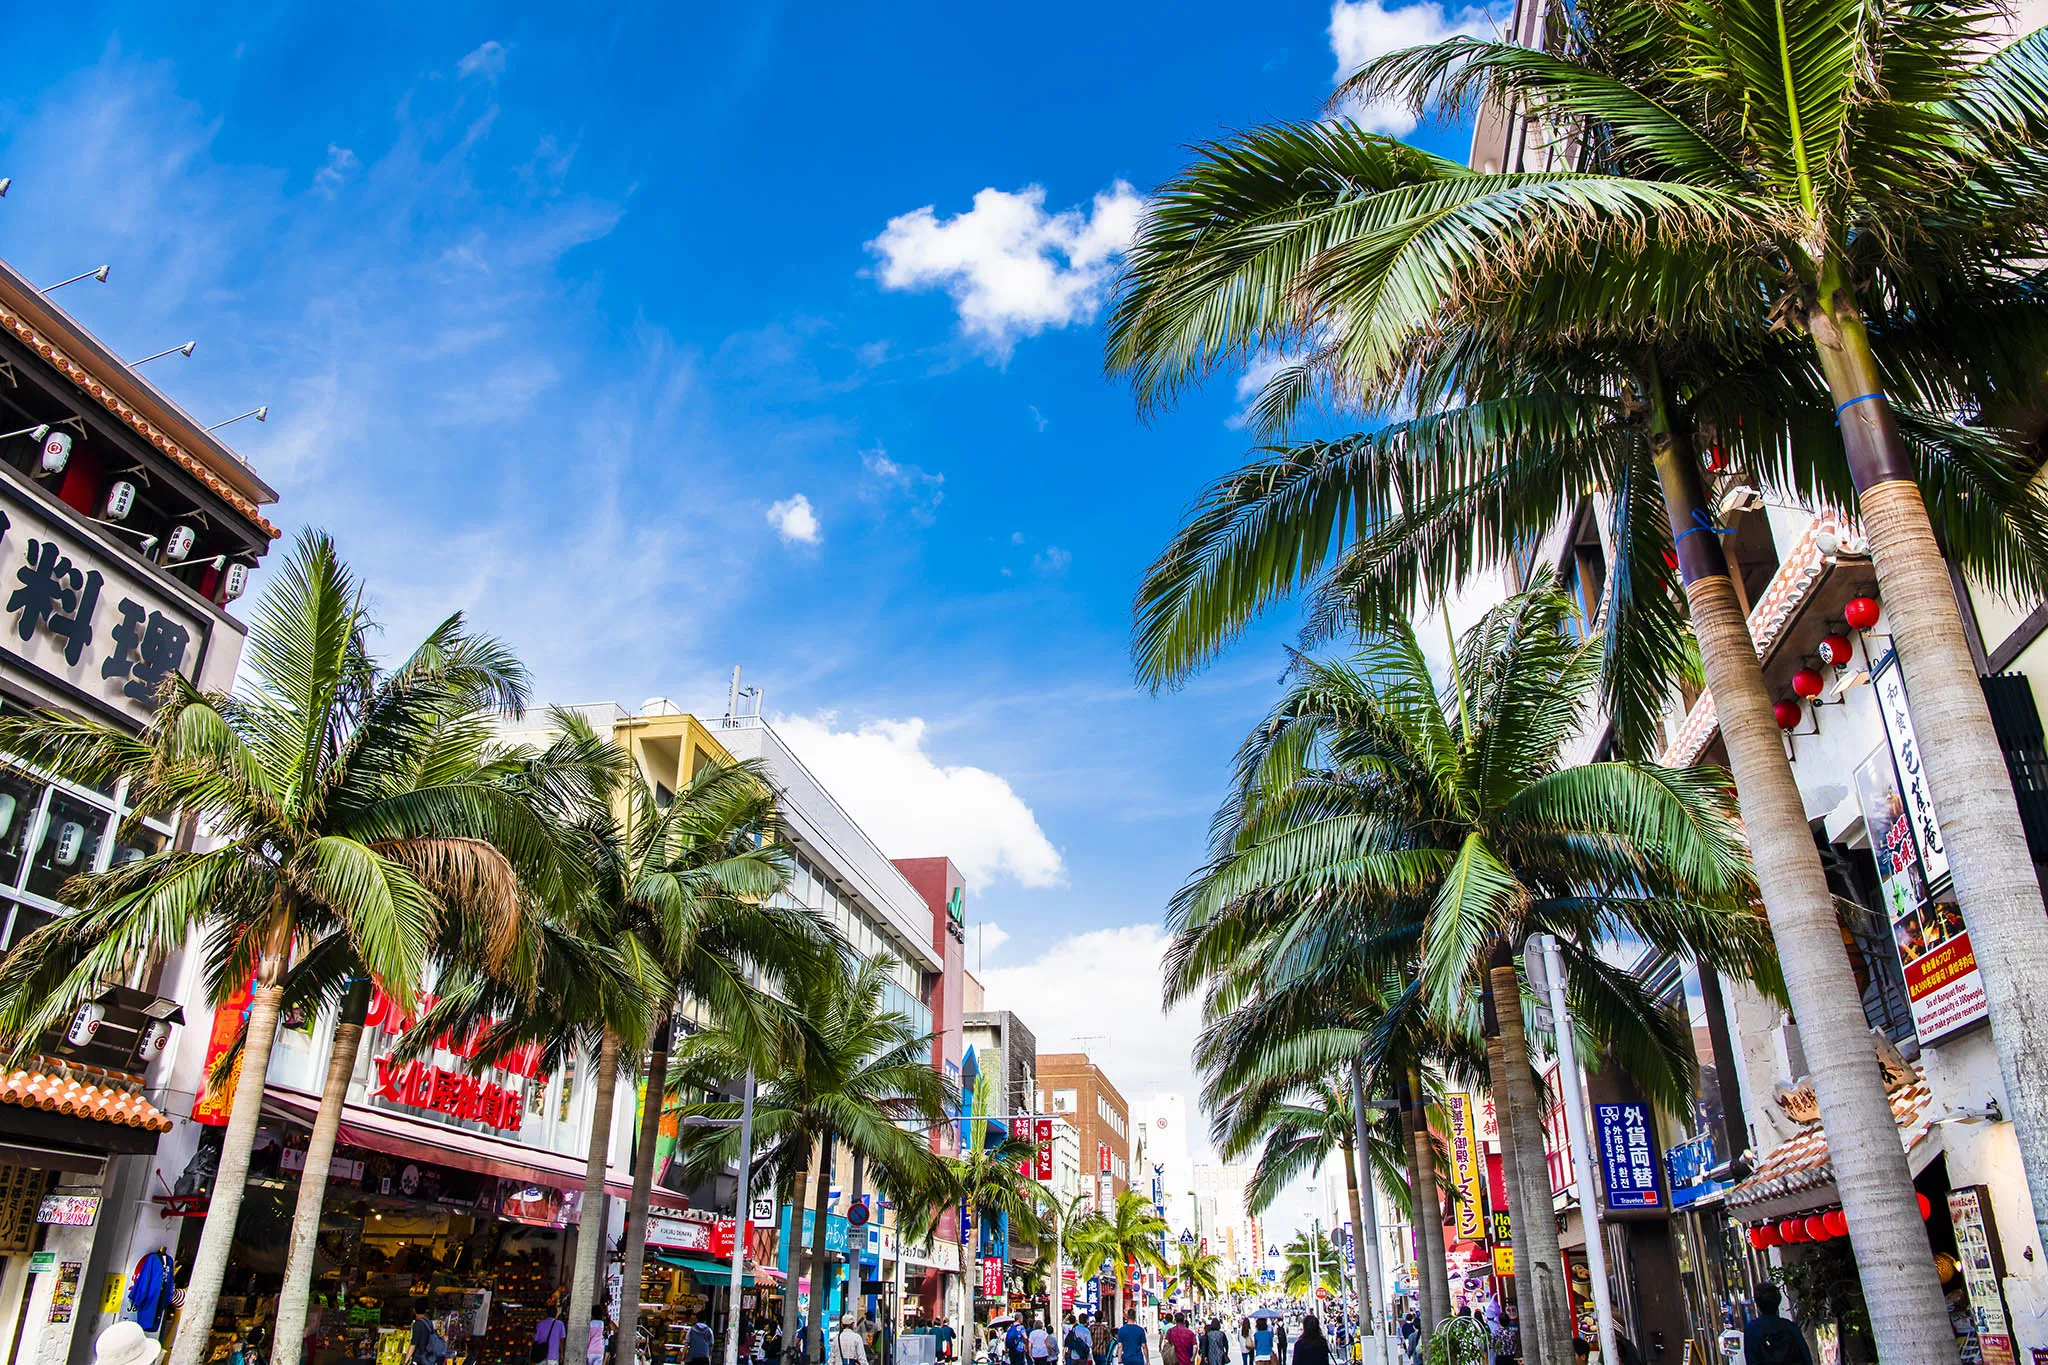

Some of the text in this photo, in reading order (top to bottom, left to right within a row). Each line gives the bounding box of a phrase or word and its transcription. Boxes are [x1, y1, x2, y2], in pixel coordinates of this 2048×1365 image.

[0, 510, 190, 706] 料理
[1603, 1126, 1618, 1190] Currency Exchange
[1624, 1106, 1653, 1188] 外貨両替
